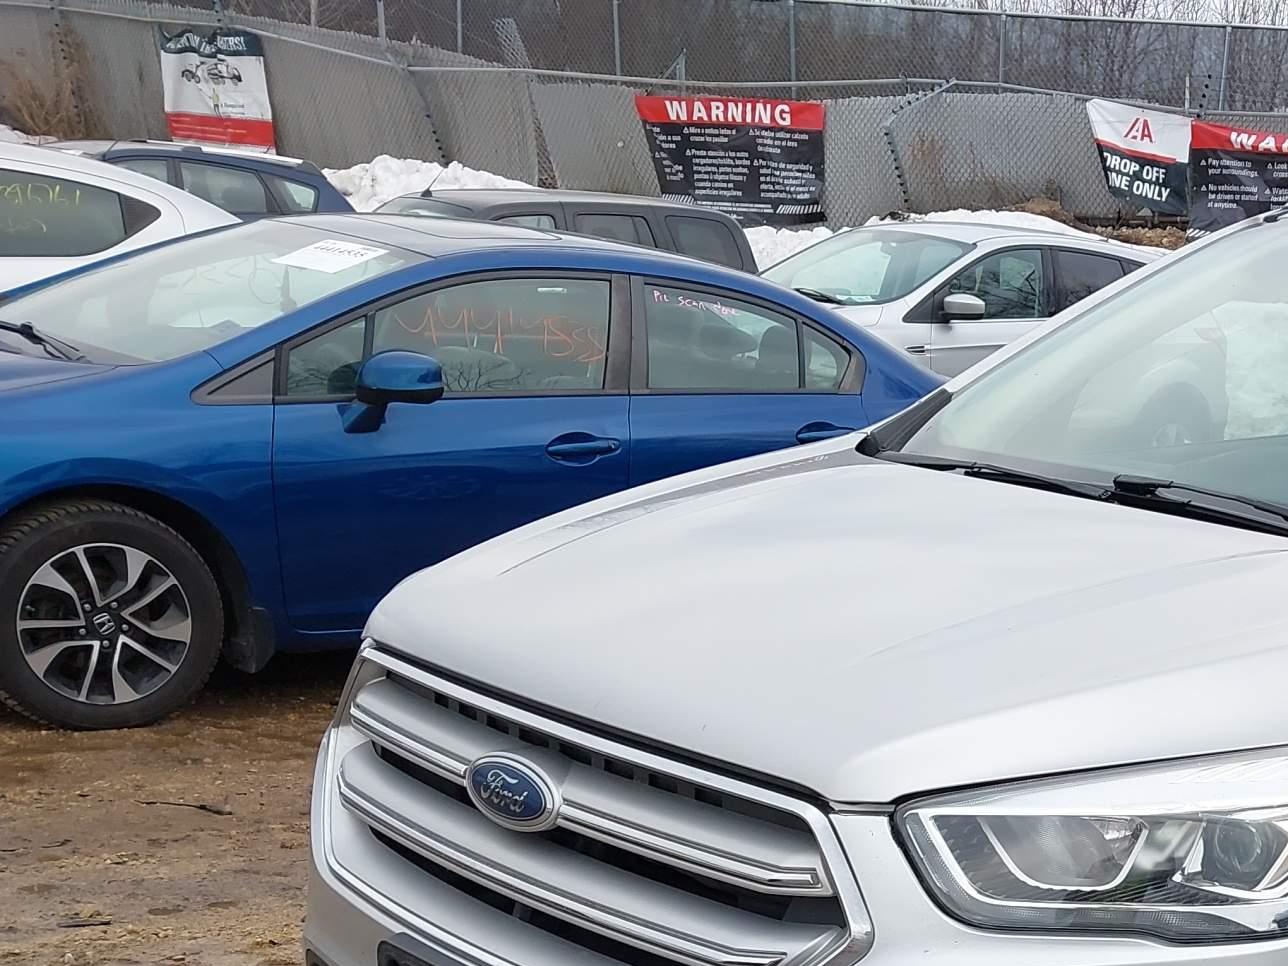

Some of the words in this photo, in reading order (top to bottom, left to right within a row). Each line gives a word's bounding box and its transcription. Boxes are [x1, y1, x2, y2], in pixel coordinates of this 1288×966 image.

[664, 100, 791, 126] WARNING
[1142, 165, 1166, 183] OFF
[1132, 180, 1170, 202] ONLY
[480, 769, 529, 813] Ford
